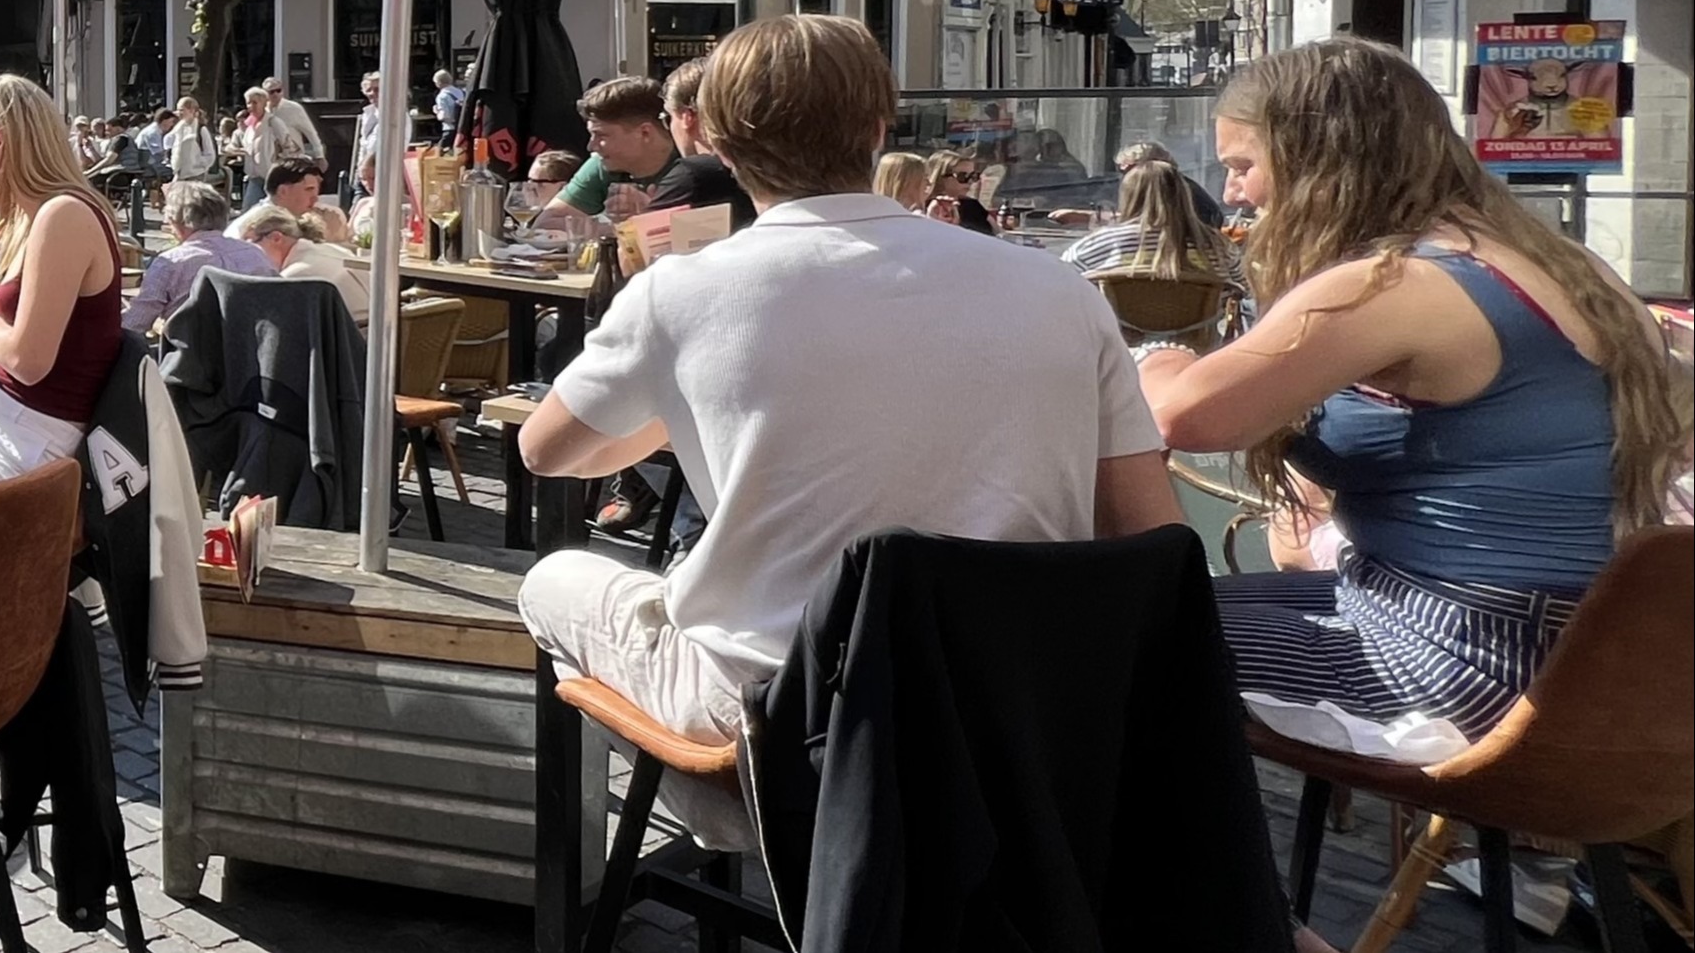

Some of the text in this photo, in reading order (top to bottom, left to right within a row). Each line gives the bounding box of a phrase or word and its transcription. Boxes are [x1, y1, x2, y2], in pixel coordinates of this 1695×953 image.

[1487, 25, 1557, 41] LENTE
[1486, 46, 1614, 61] BIERTOCHT
[1484, 141, 1546, 151] ZONDAG
[1567, 141, 1613, 151] APRIL
[86, 424, 149, 516] A
